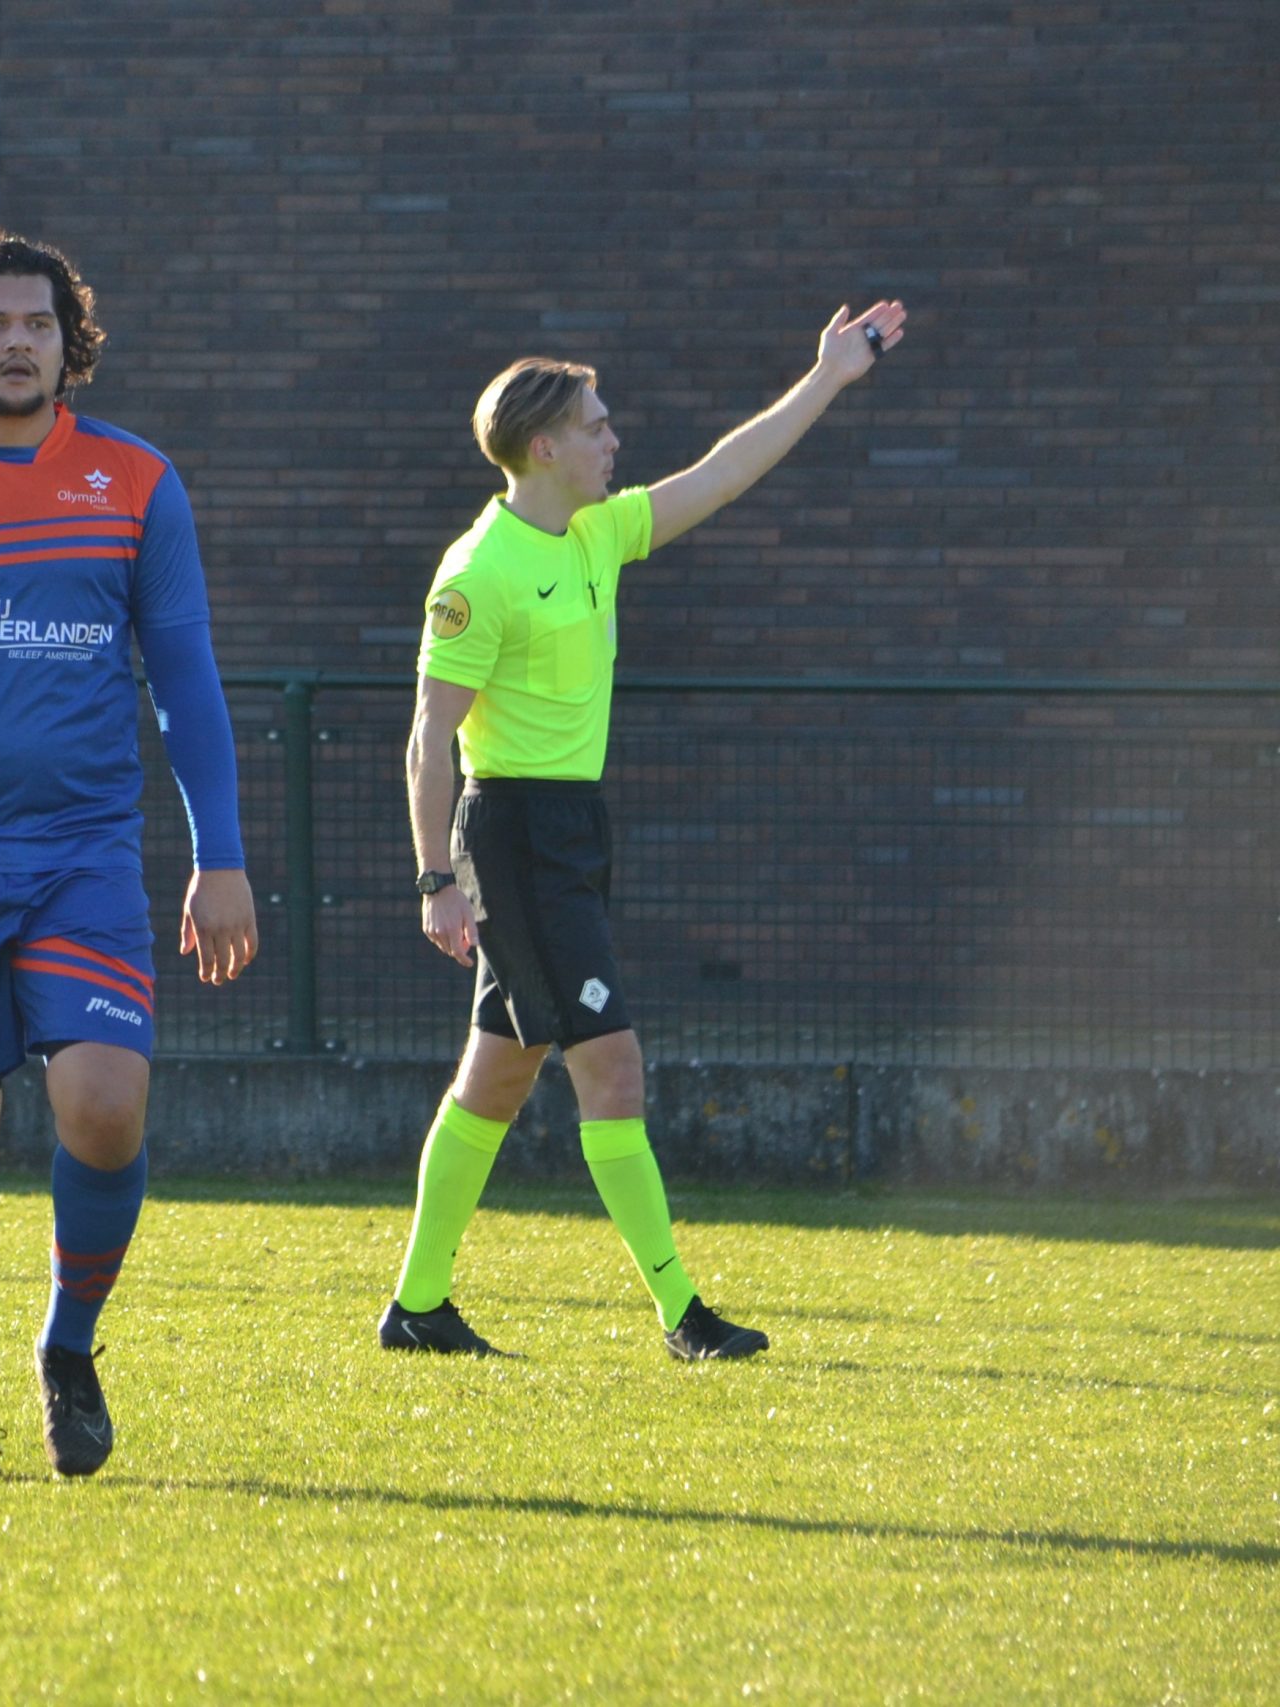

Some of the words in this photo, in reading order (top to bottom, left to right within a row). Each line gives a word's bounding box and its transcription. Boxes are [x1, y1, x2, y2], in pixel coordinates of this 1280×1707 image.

[57, 489, 107, 505] Olympia
[8, 649, 43, 659] BELEEF
[44, 651, 93, 661] AMSTERDAM
[105, 1006, 142, 1026] muta
